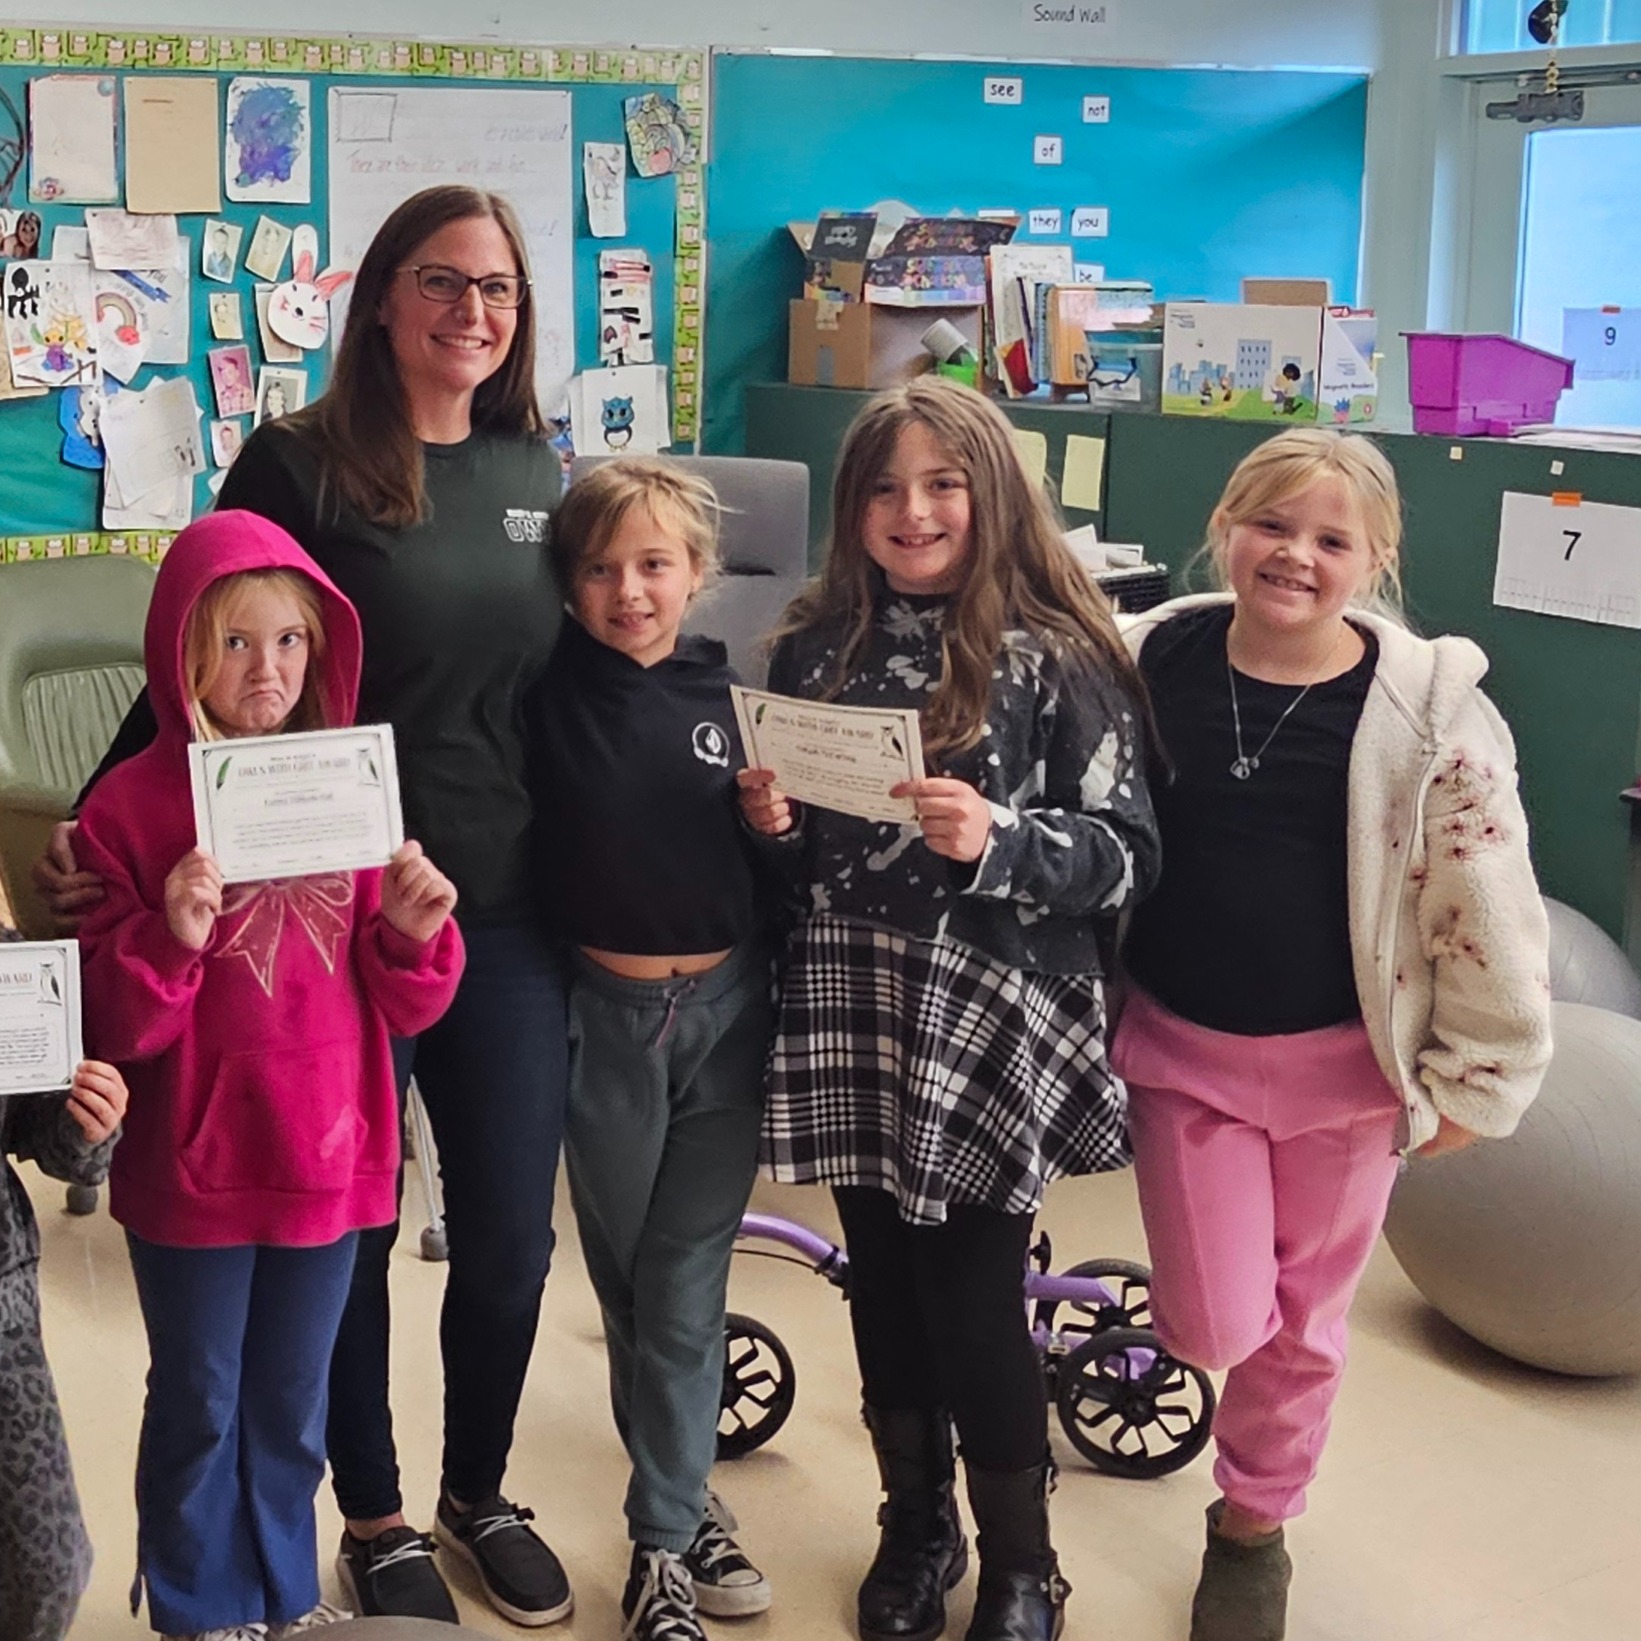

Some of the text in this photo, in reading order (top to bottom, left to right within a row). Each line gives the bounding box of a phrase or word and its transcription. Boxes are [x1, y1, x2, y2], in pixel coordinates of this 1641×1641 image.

[1033, 3, 1106, 23] Sound Wall
[990, 83, 1015, 97] see
[1087, 105, 1106, 117] not
[1041, 143, 1056, 158] of
[1033, 214, 1059, 231] they
[1077, 217, 1099, 232] you
[1604, 326, 1617, 346] 9
[1562, 529, 1582, 561] 7
